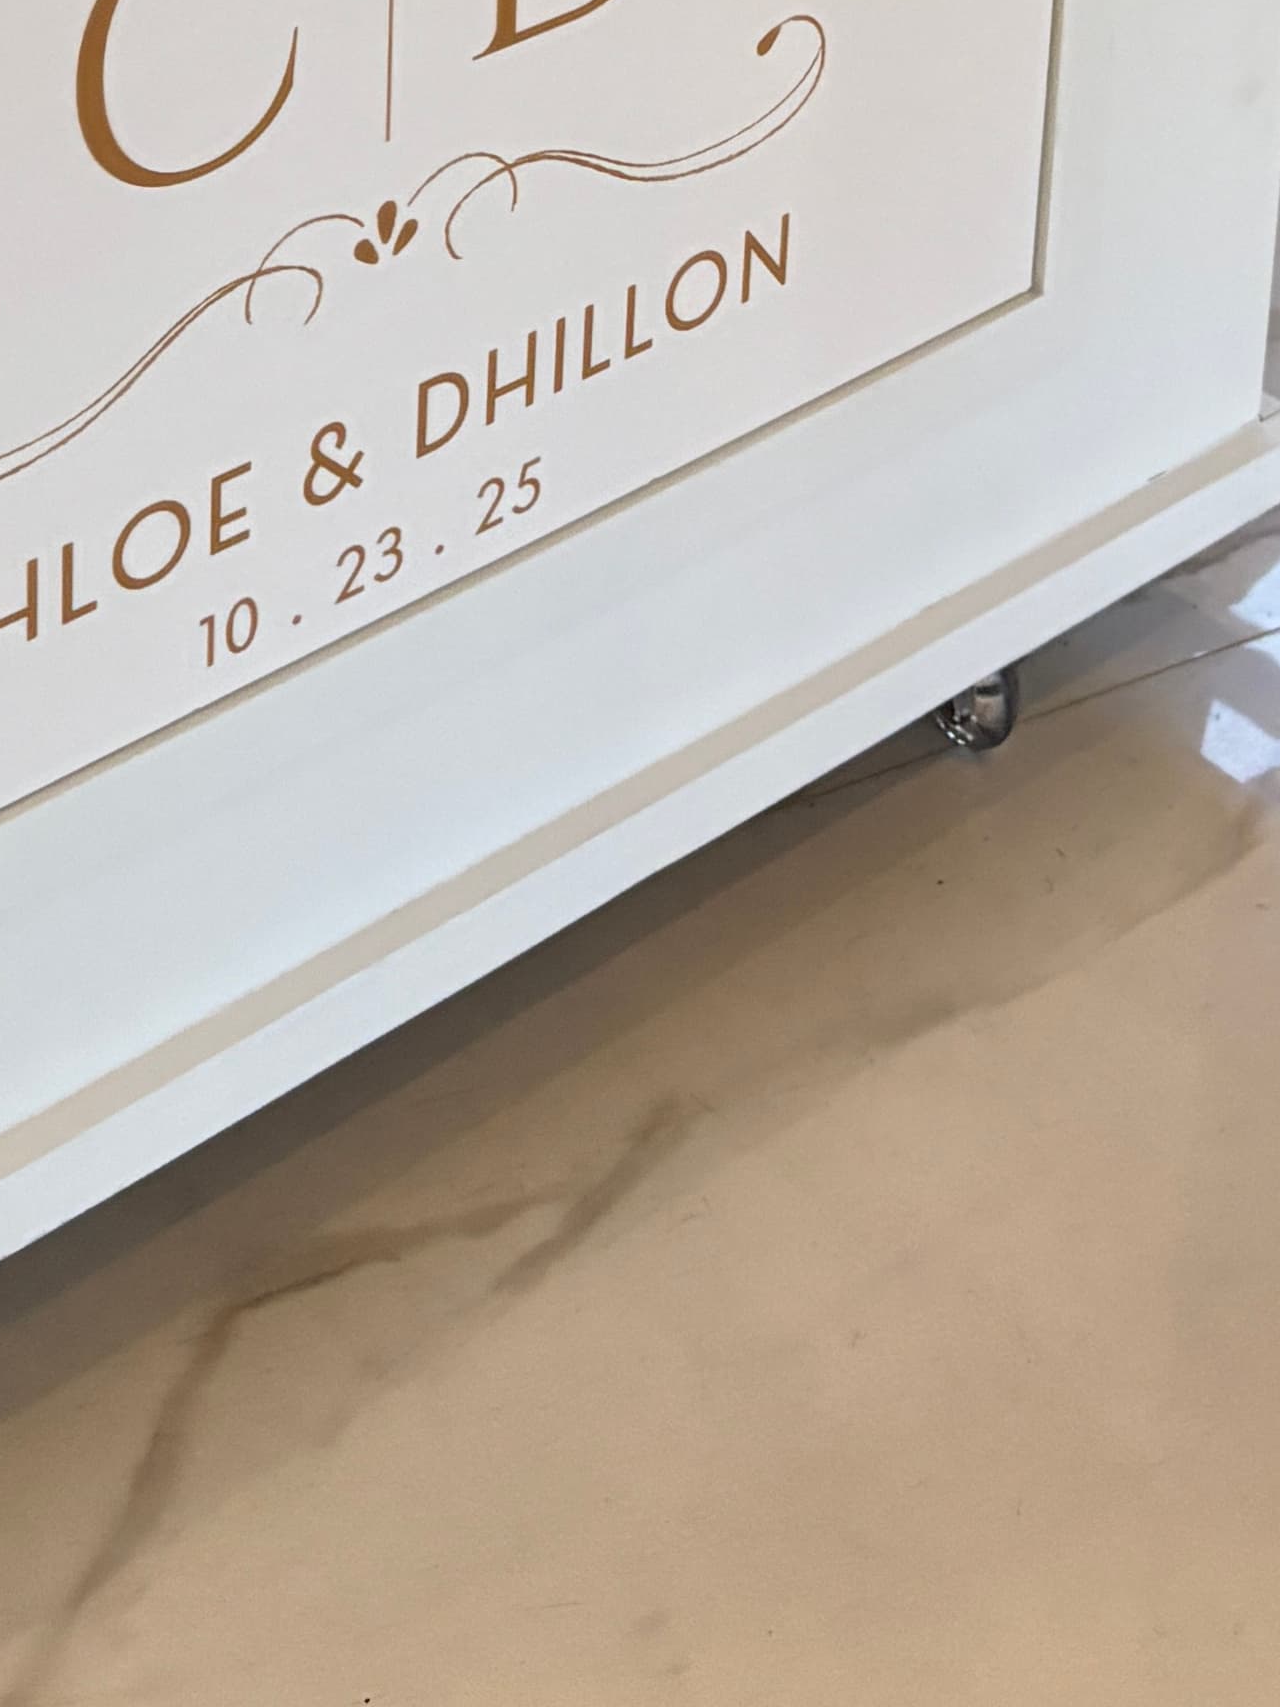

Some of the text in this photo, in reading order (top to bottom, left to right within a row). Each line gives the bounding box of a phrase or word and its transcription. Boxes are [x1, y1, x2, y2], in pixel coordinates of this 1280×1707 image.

[303, 422, 365, 505] &
[416, 212, 793, 459] DHILLON
[199, 595, 258, 667] 10
[334, 526, 403, 603] 23
[475, 456, 543, 533] 25
